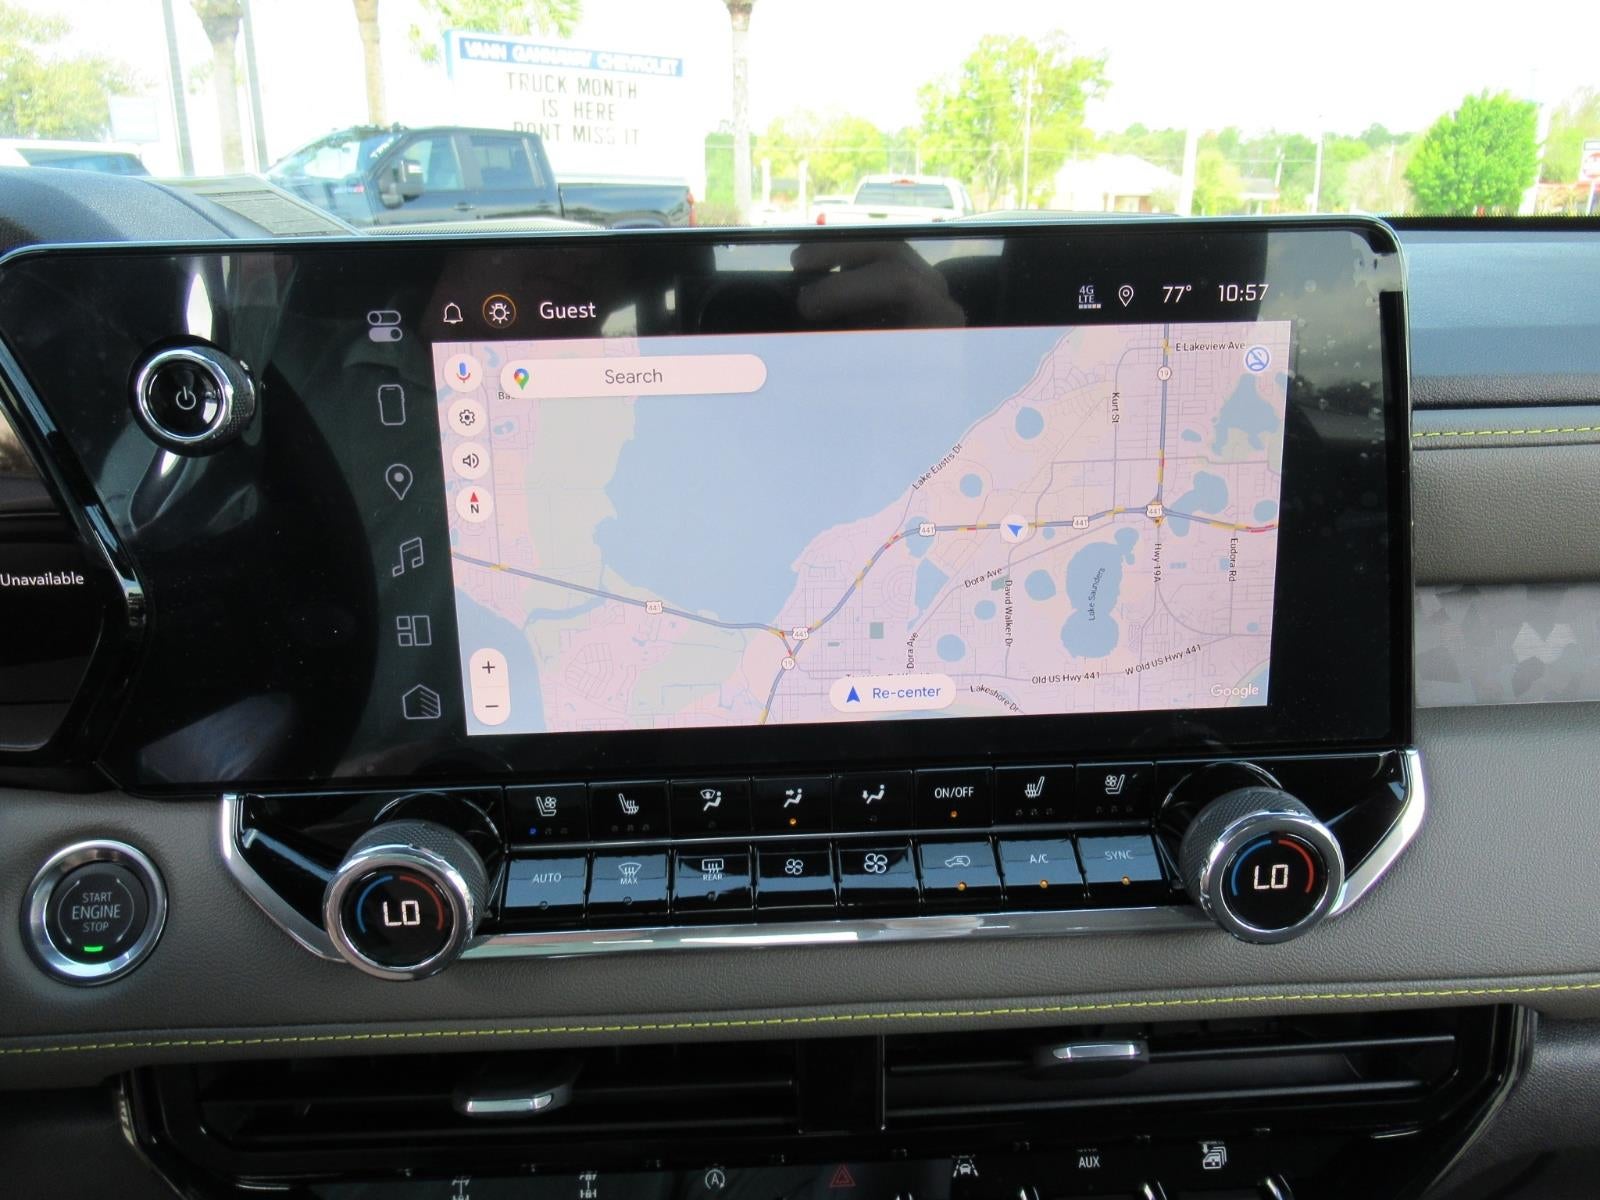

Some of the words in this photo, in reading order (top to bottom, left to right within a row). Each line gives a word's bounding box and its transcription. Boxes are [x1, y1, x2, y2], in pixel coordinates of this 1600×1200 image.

[506, 72, 567, 94] TRUCK
[577, 77, 637, 99] MONTH
[542, 98, 558, 118] IS
[574, 101, 615, 121] HERE
[513, 121, 560, 141] DONT
[573, 125, 615, 145] MISS
[625, 128, 639, 145] IT
[1079, 285, 1094, 295] 4G
[1163, 285, 1192, 303] 77°
[1218, 284, 1269, 302] 10:57
[1078, 295, 1094, 303] LTE
[540, 302, 596, 319] Guest
[1176, 342, 1181, 352] E
[1184, 342, 1225, 352] Lakeview
[1227, 341, 1245, 350] Ave
[604, 368, 663, 385] Search
[1112, 392, 1120, 412] Kurt
[1112, 413, 1120, 423] St
[912, 472, 931, 490] Lake
[930, 453, 955, 474] Eustis
[952, 443, 963, 454] Dr
[470, 503, 480, 515] N
[921, 526, 935, 534] 441
[1074, 519, 1087, 527] 441
[1154, 543, 1162, 563] Hwy
[1229, 538, 1238, 568] Eudora
[0, 572, 84, 587] Unavailable
[964, 574, 985, 589] Dora
[986, 567, 1003, 579] Ave
[1154, 564, 1162, 583] 19A
[1228, 570, 1237, 582] Rd
[1089, 567, 1106, 601] Saunders
[1005, 580, 1013, 606] David
[1088, 603, 1096, 621] Lake
[1005, 607, 1014, 637] Walker
[907, 632, 918, 646] Ave
[1005, 638, 1013, 647] Dr
[906, 647, 915, 669] Dora
[1125, 666, 1133, 676] W
[1135, 662, 1150, 673] Old
[1151, 658, 1164, 669] US
[1165, 651, 1184, 664] Hwy
[1185, 644, 1201, 655] 441
[1032, 675, 1047, 684] Old
[1049, 675, 1061, 683] US
[1063, 673, 1081, 685] Hwy
[1084, 671, 1100, 680] 441
[872, 686, 941, 699] Re-center
[970, 684, 1010, 706] Lakeshore
[1009, 702, 1019, 712] Dr
[1211, 684, 1259, 698] Google
[934, 786, 974, 799] ON/OFF
[1029, 853, 1049, 865] A/C
[1104, 849, 1135, 861] SYNC
[532, 872, 562, 884] AUTO
[620, 877, 639, 886] MAX
[702, 873, 723, 882] REAR
[1254, 864, 1289, 890] LO
[82, 892, 112, 903] START
[72, 903, 121, 920] ENGINE
[383, 900, 420, 927] LO
[82, 921, 109, 933] STOP
[1078, 1155, 1100, 1169] AUX
